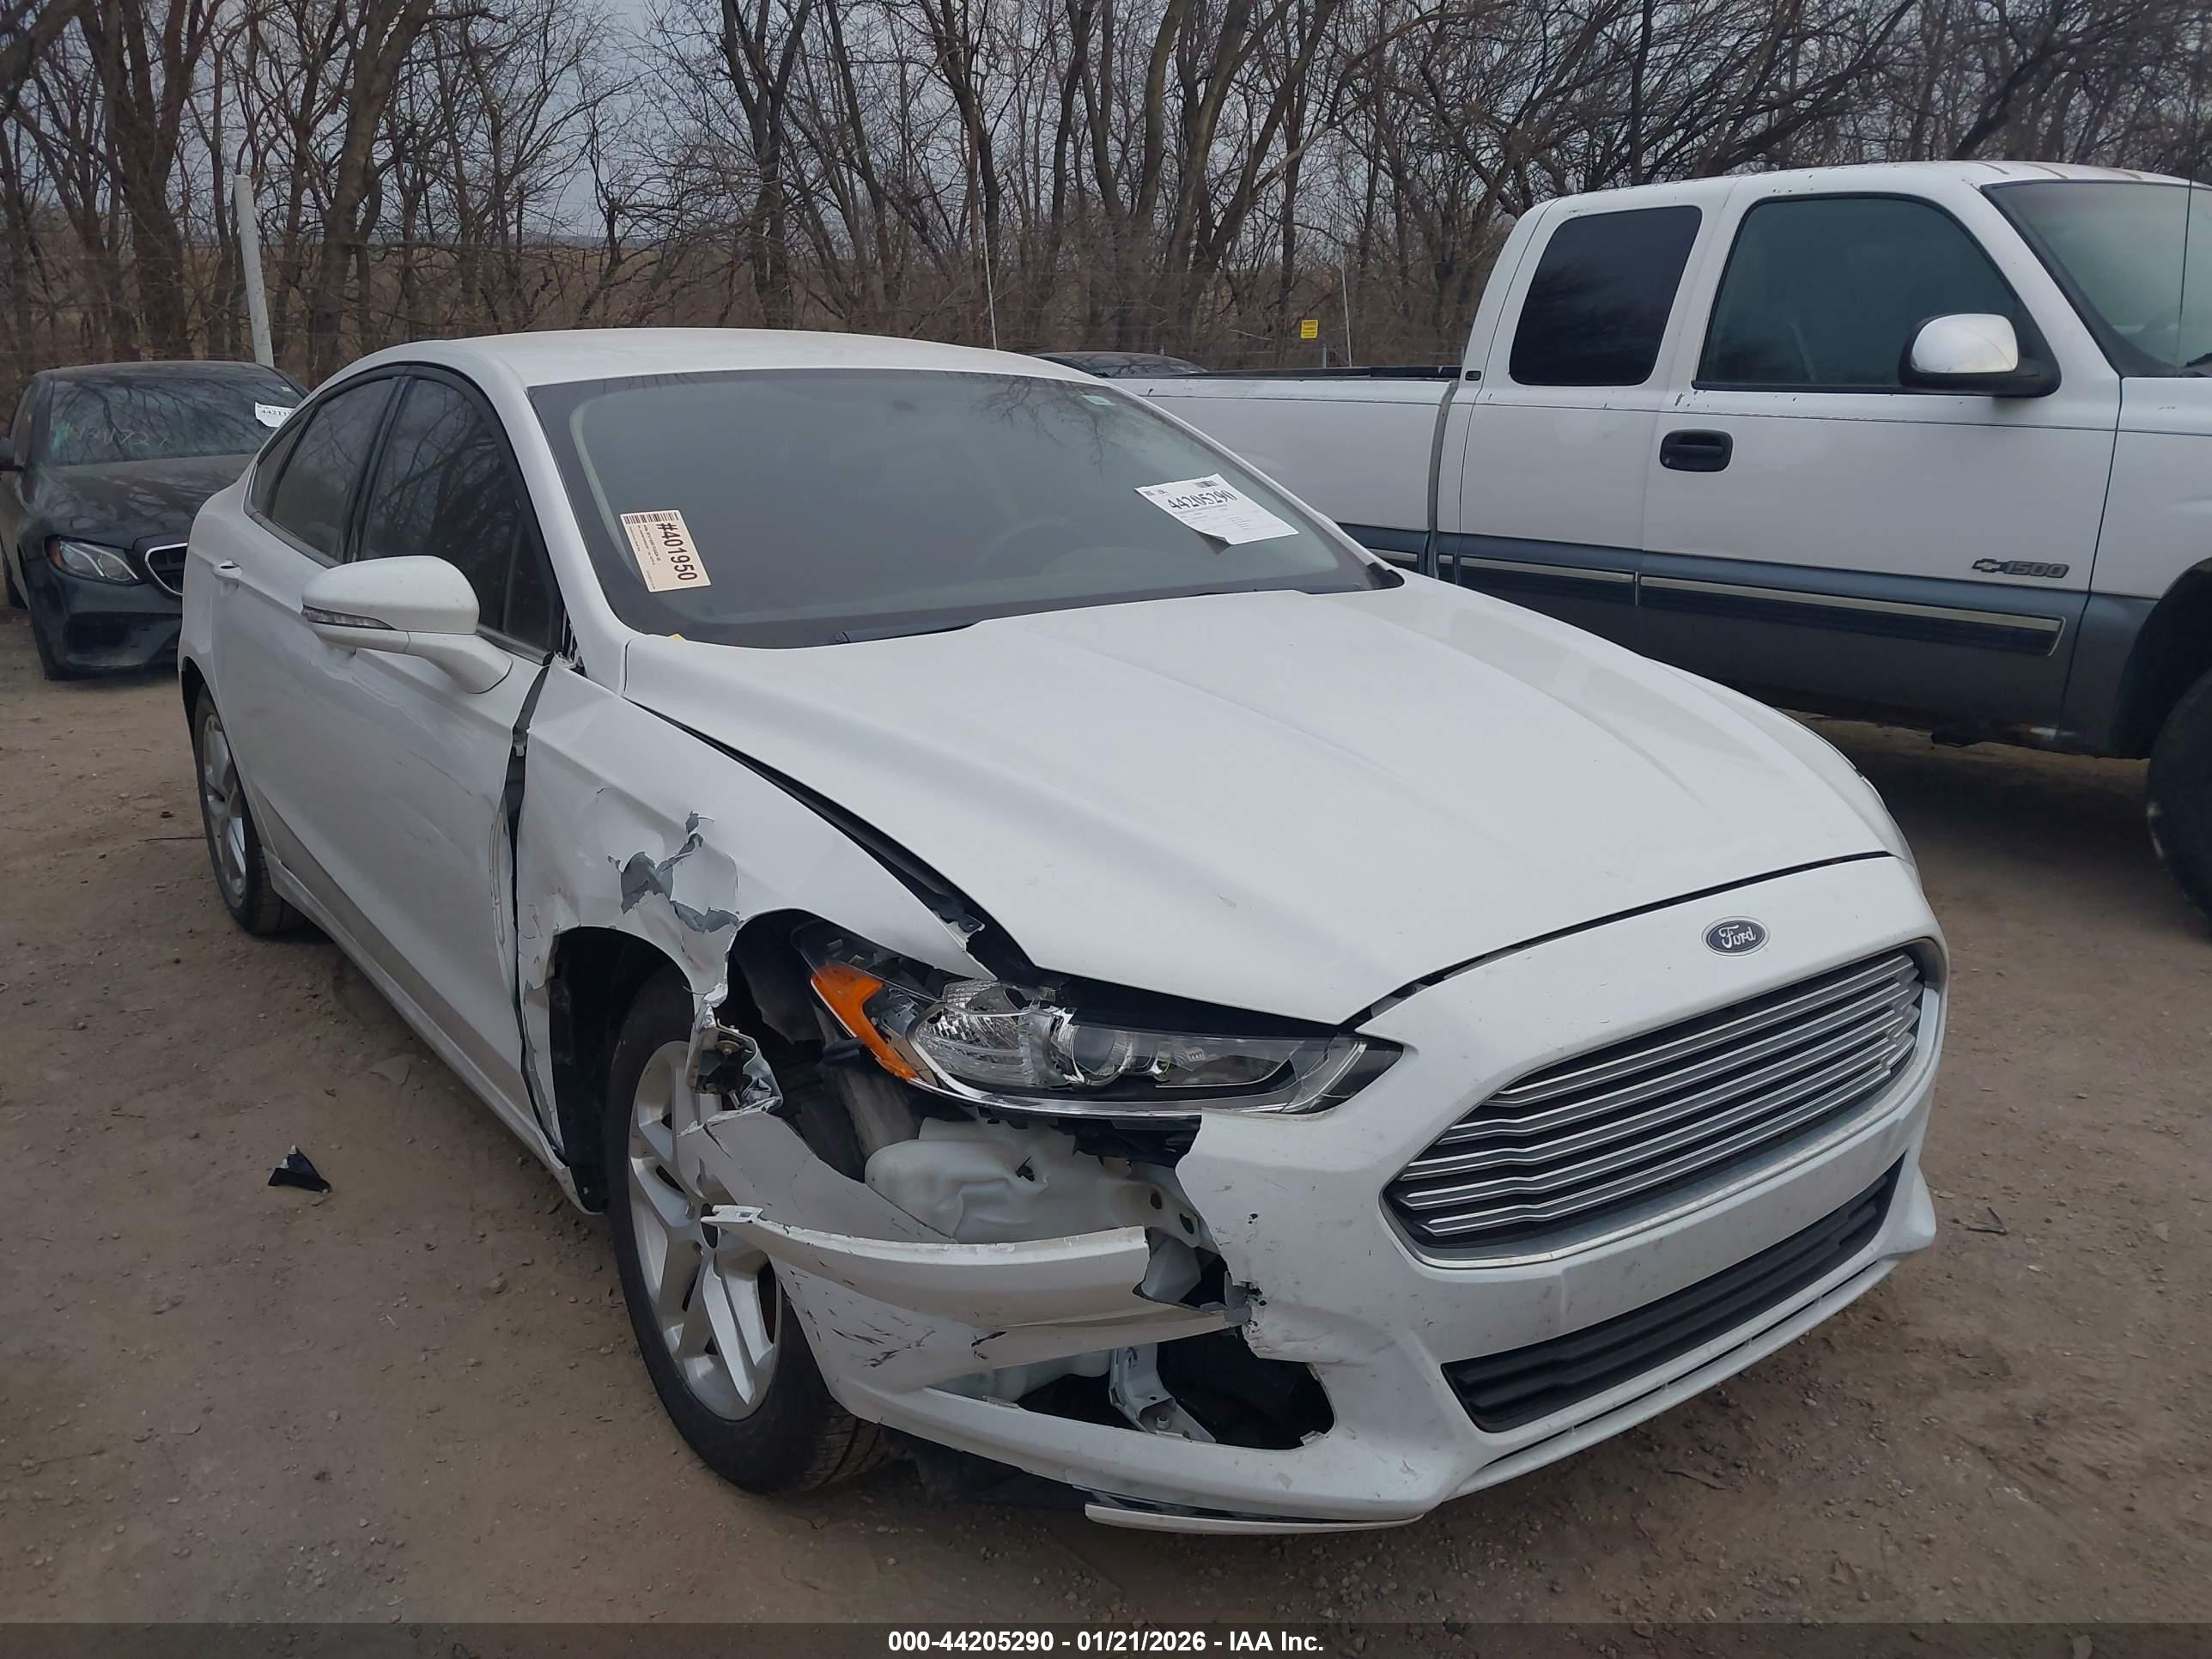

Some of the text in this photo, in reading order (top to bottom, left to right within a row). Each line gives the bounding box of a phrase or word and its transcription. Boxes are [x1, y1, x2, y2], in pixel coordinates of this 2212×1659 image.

[1167, 489, 1238, 511] 44205290
[655, 522, 698, 581] #401950
[2003, 560, 2069, 579] 1500
[1718, 924, 1757, 949] Ford
